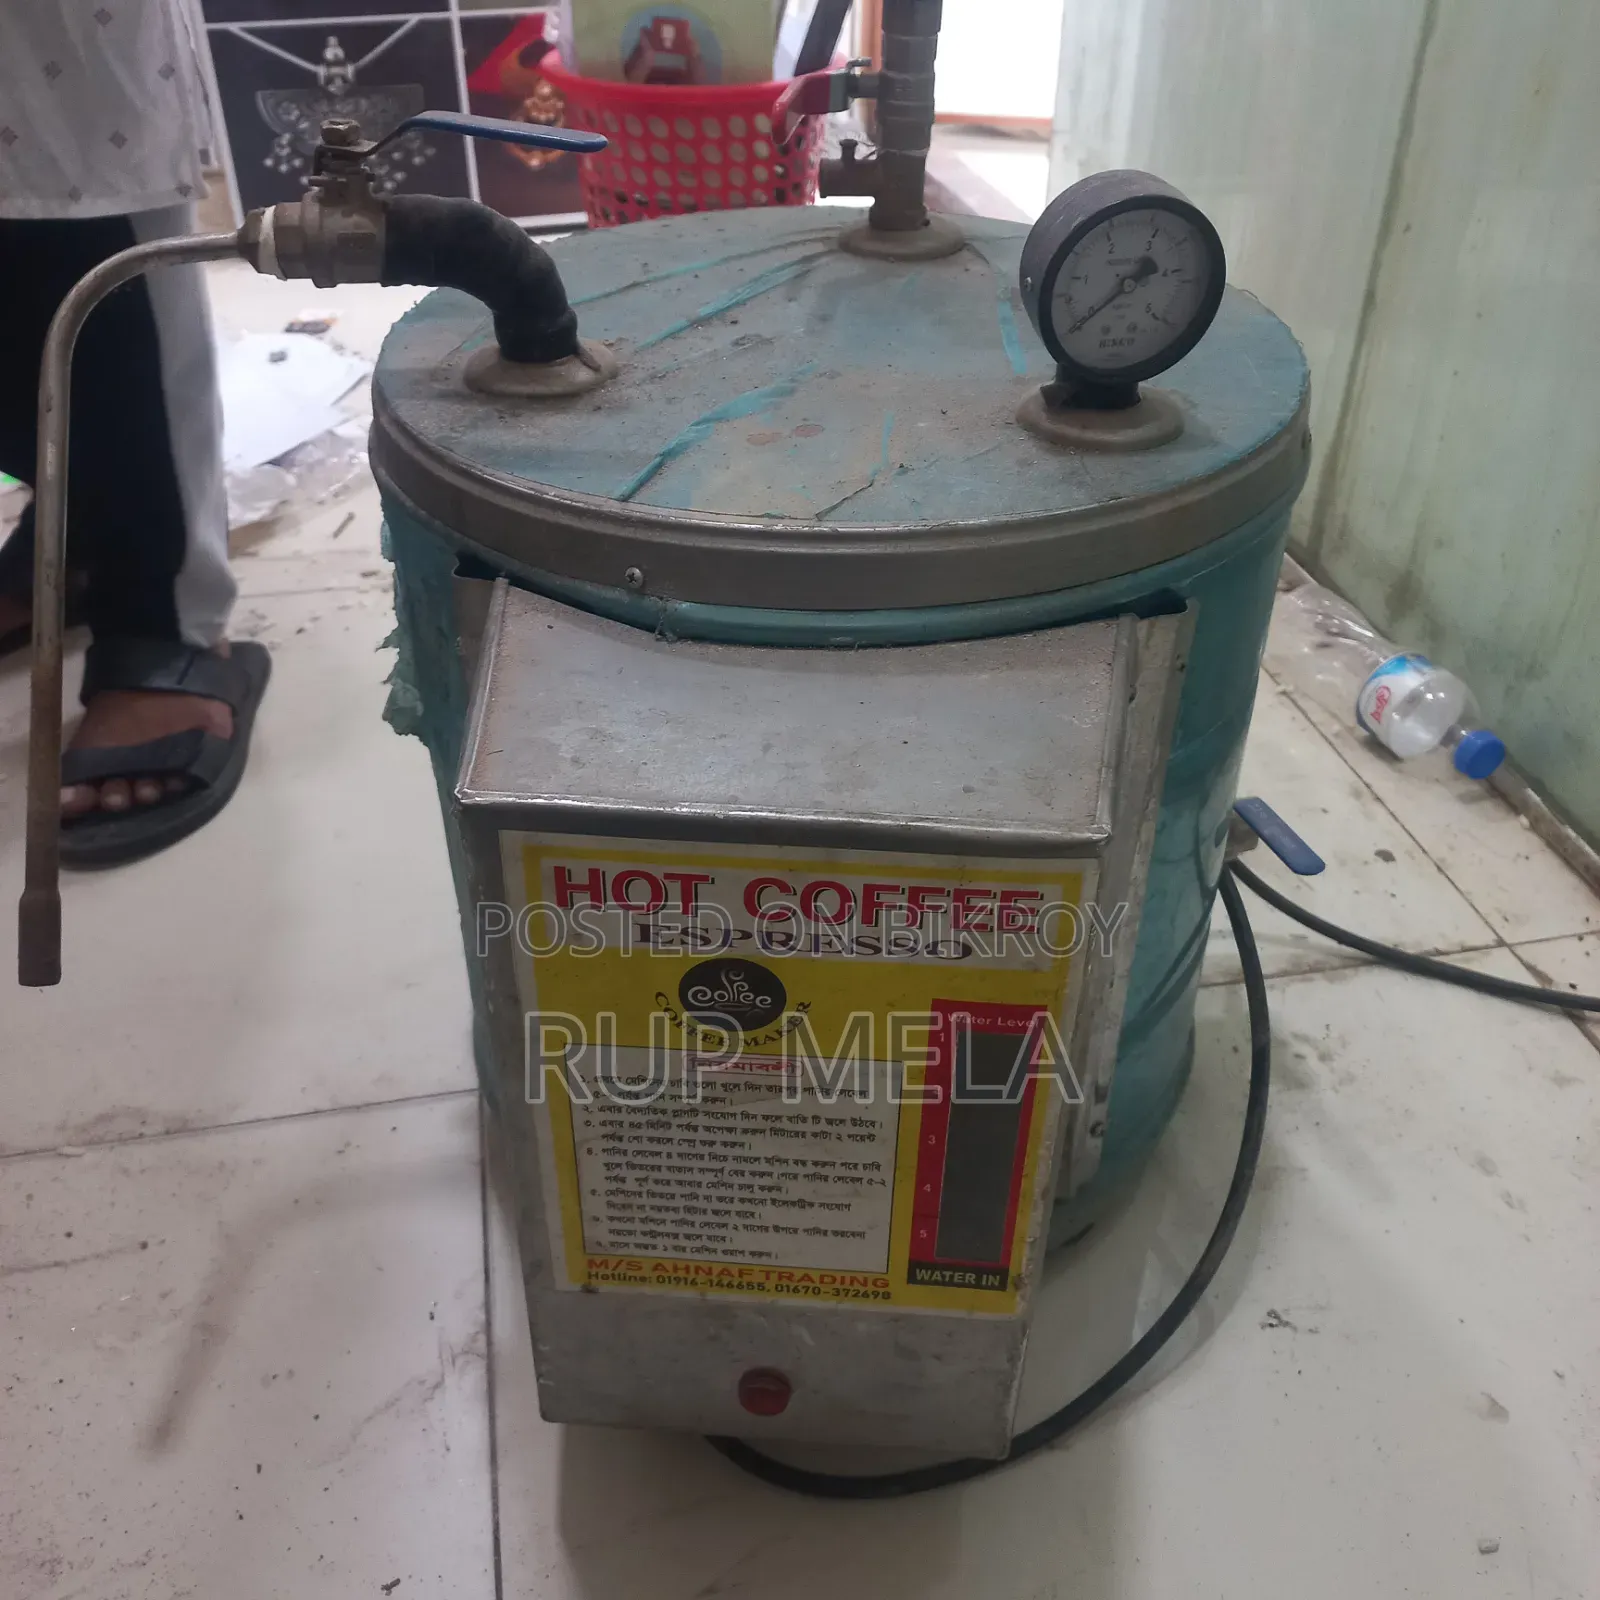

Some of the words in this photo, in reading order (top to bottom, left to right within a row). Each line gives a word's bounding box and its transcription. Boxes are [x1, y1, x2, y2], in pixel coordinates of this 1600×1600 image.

[553, 866, 715, 918] HOT
[743, 877, 1043, 934] COFFEE
[632, 923, 973, 960] ESPRESSO
[947, 1013, 992, 1026] Water
[997, 1016, 1040, 1029] Level
[743, 1080, 761, 1092] দিন
[740, 1110, 758, 1121] দিন
[836, 1133, 842, 1141] ২
[927, 1135, 936, 1145] 3
[923, 1183, 932, 1193] 4
[920, 1229, 927, 1239] 5
[587, 1258, 644, 1272] M/S
[652, 1262, 754, 1279] AHNAF
[758, 1269, 890, 1289] TRADING
[587, 1271, 652, 1284] Hotline:
[915, 1268, 977, 1285] WATER
[981, 1273, 1000, 1287] IN
